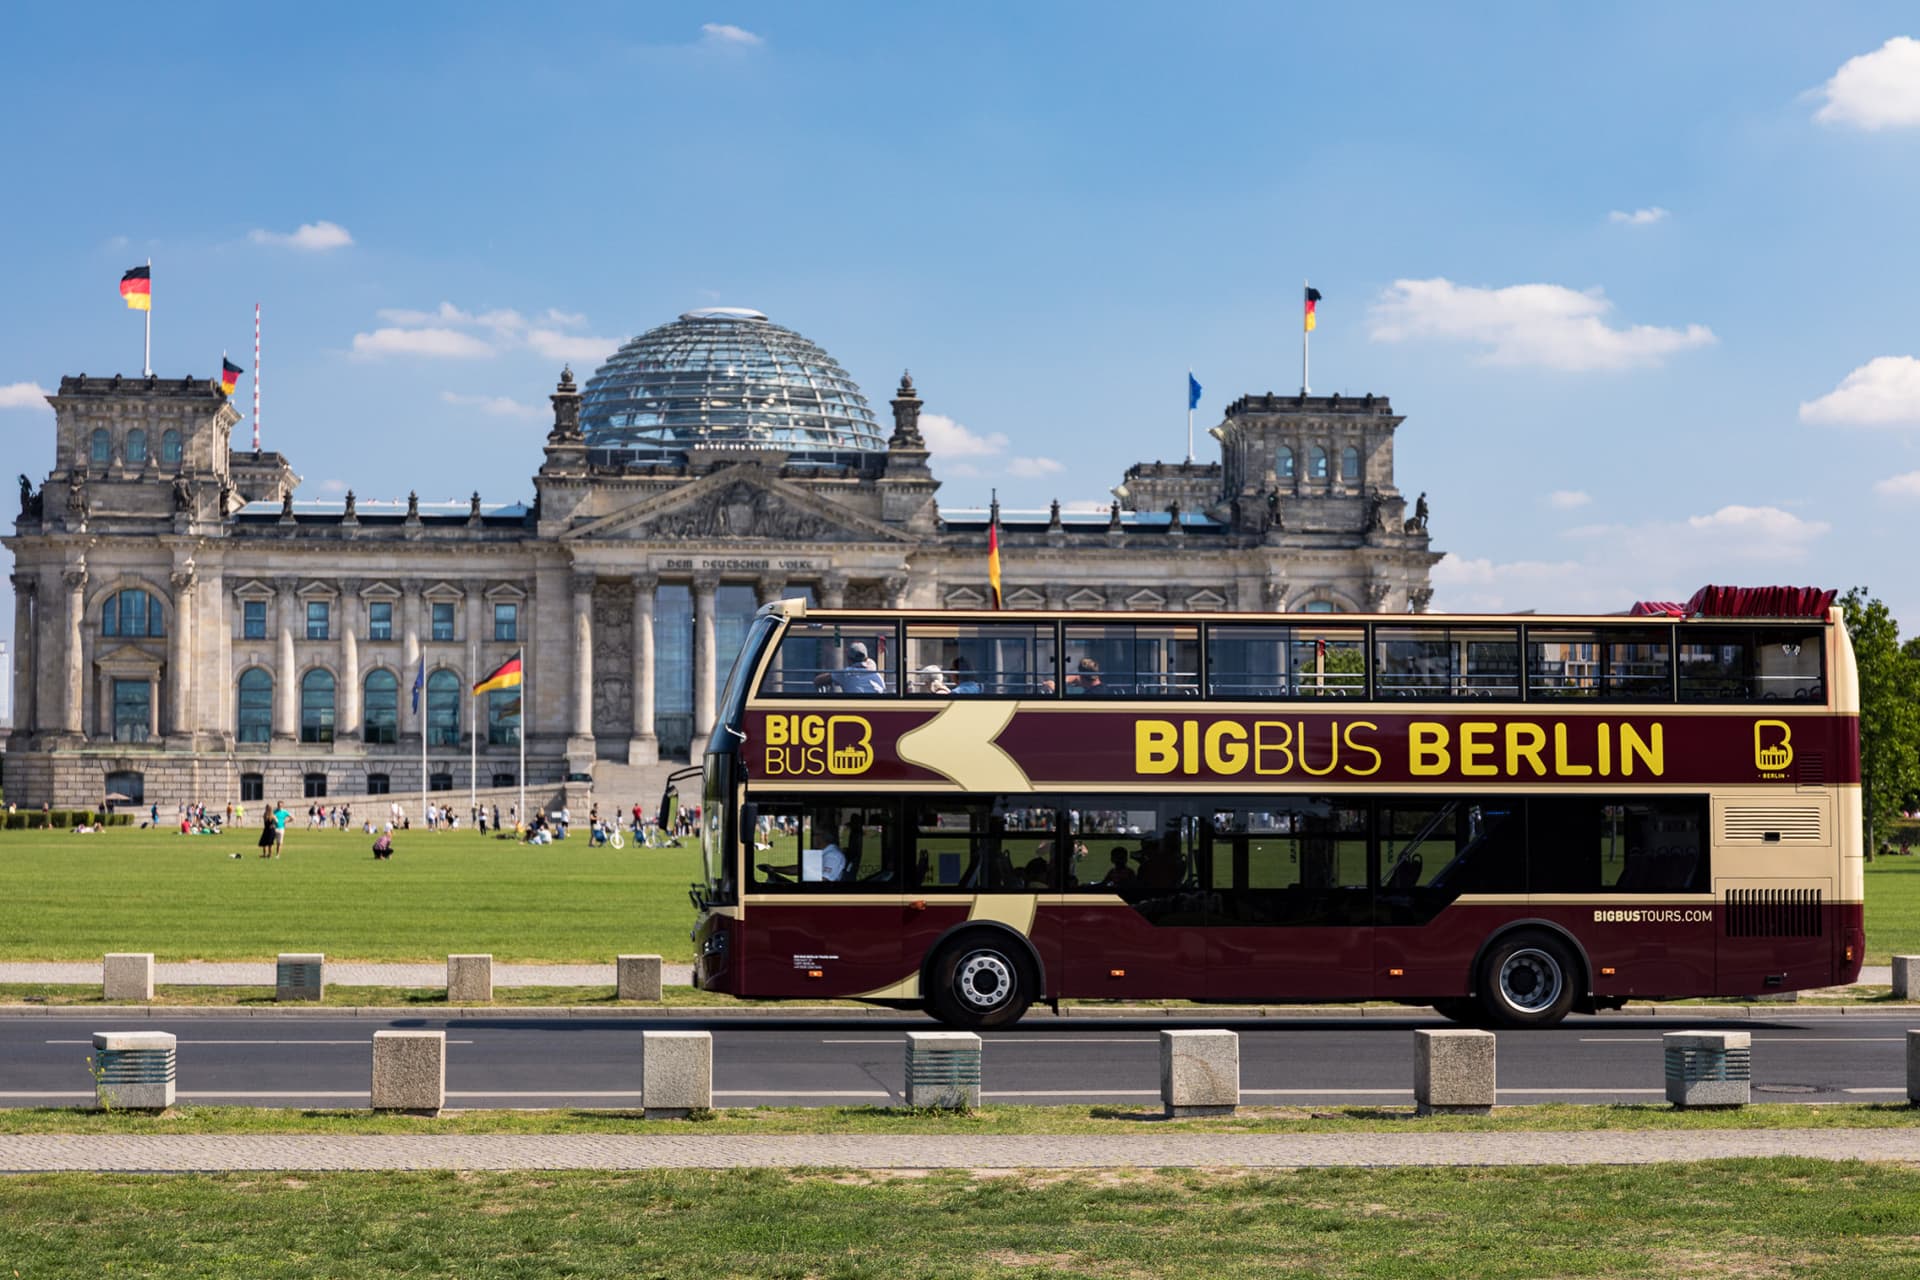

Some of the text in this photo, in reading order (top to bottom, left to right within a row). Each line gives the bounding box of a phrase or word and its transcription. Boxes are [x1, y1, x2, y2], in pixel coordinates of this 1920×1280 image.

[667, 559, 693, 569] DEM
[702, 559, 769, 570] DEUTSCHEN
[765, 714, 825, 746] BIG
[765, 746, 825, 775] BUS
[1135, 720, 1665, 776] BIGBUS BERLIN
[1593, 910, 1713, 922] BIGBUSTOURS.COM
